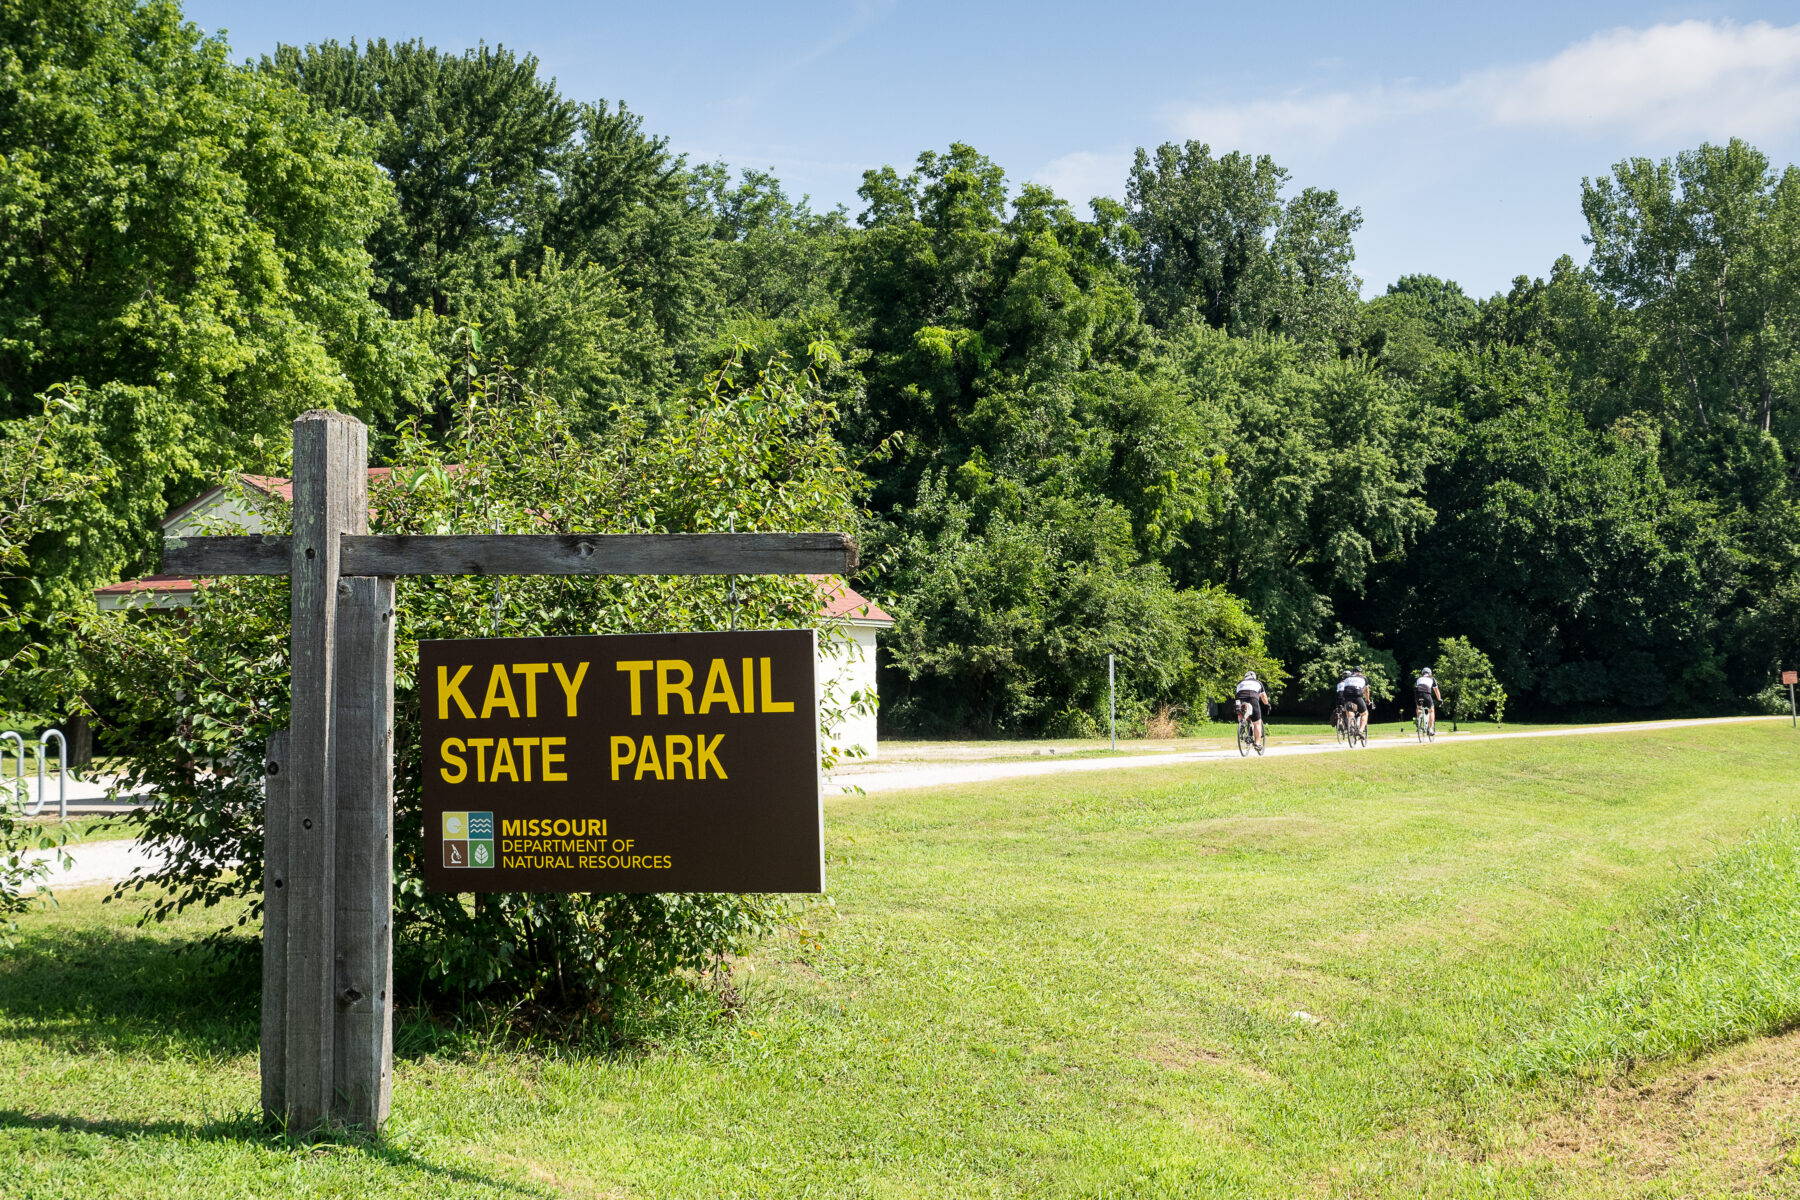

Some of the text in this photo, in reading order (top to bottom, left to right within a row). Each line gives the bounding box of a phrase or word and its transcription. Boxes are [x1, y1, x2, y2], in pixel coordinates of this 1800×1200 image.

[438, 657, 795, 720] KATY TRAIL
[440, 734, 729, 784] STATE PARK
[502, 818, 608, 837] MISSOURI
[502, 839, 635, 853] DEPARTMENT OF
[502, 855, 672, 869] NATURAL RESOURCES
